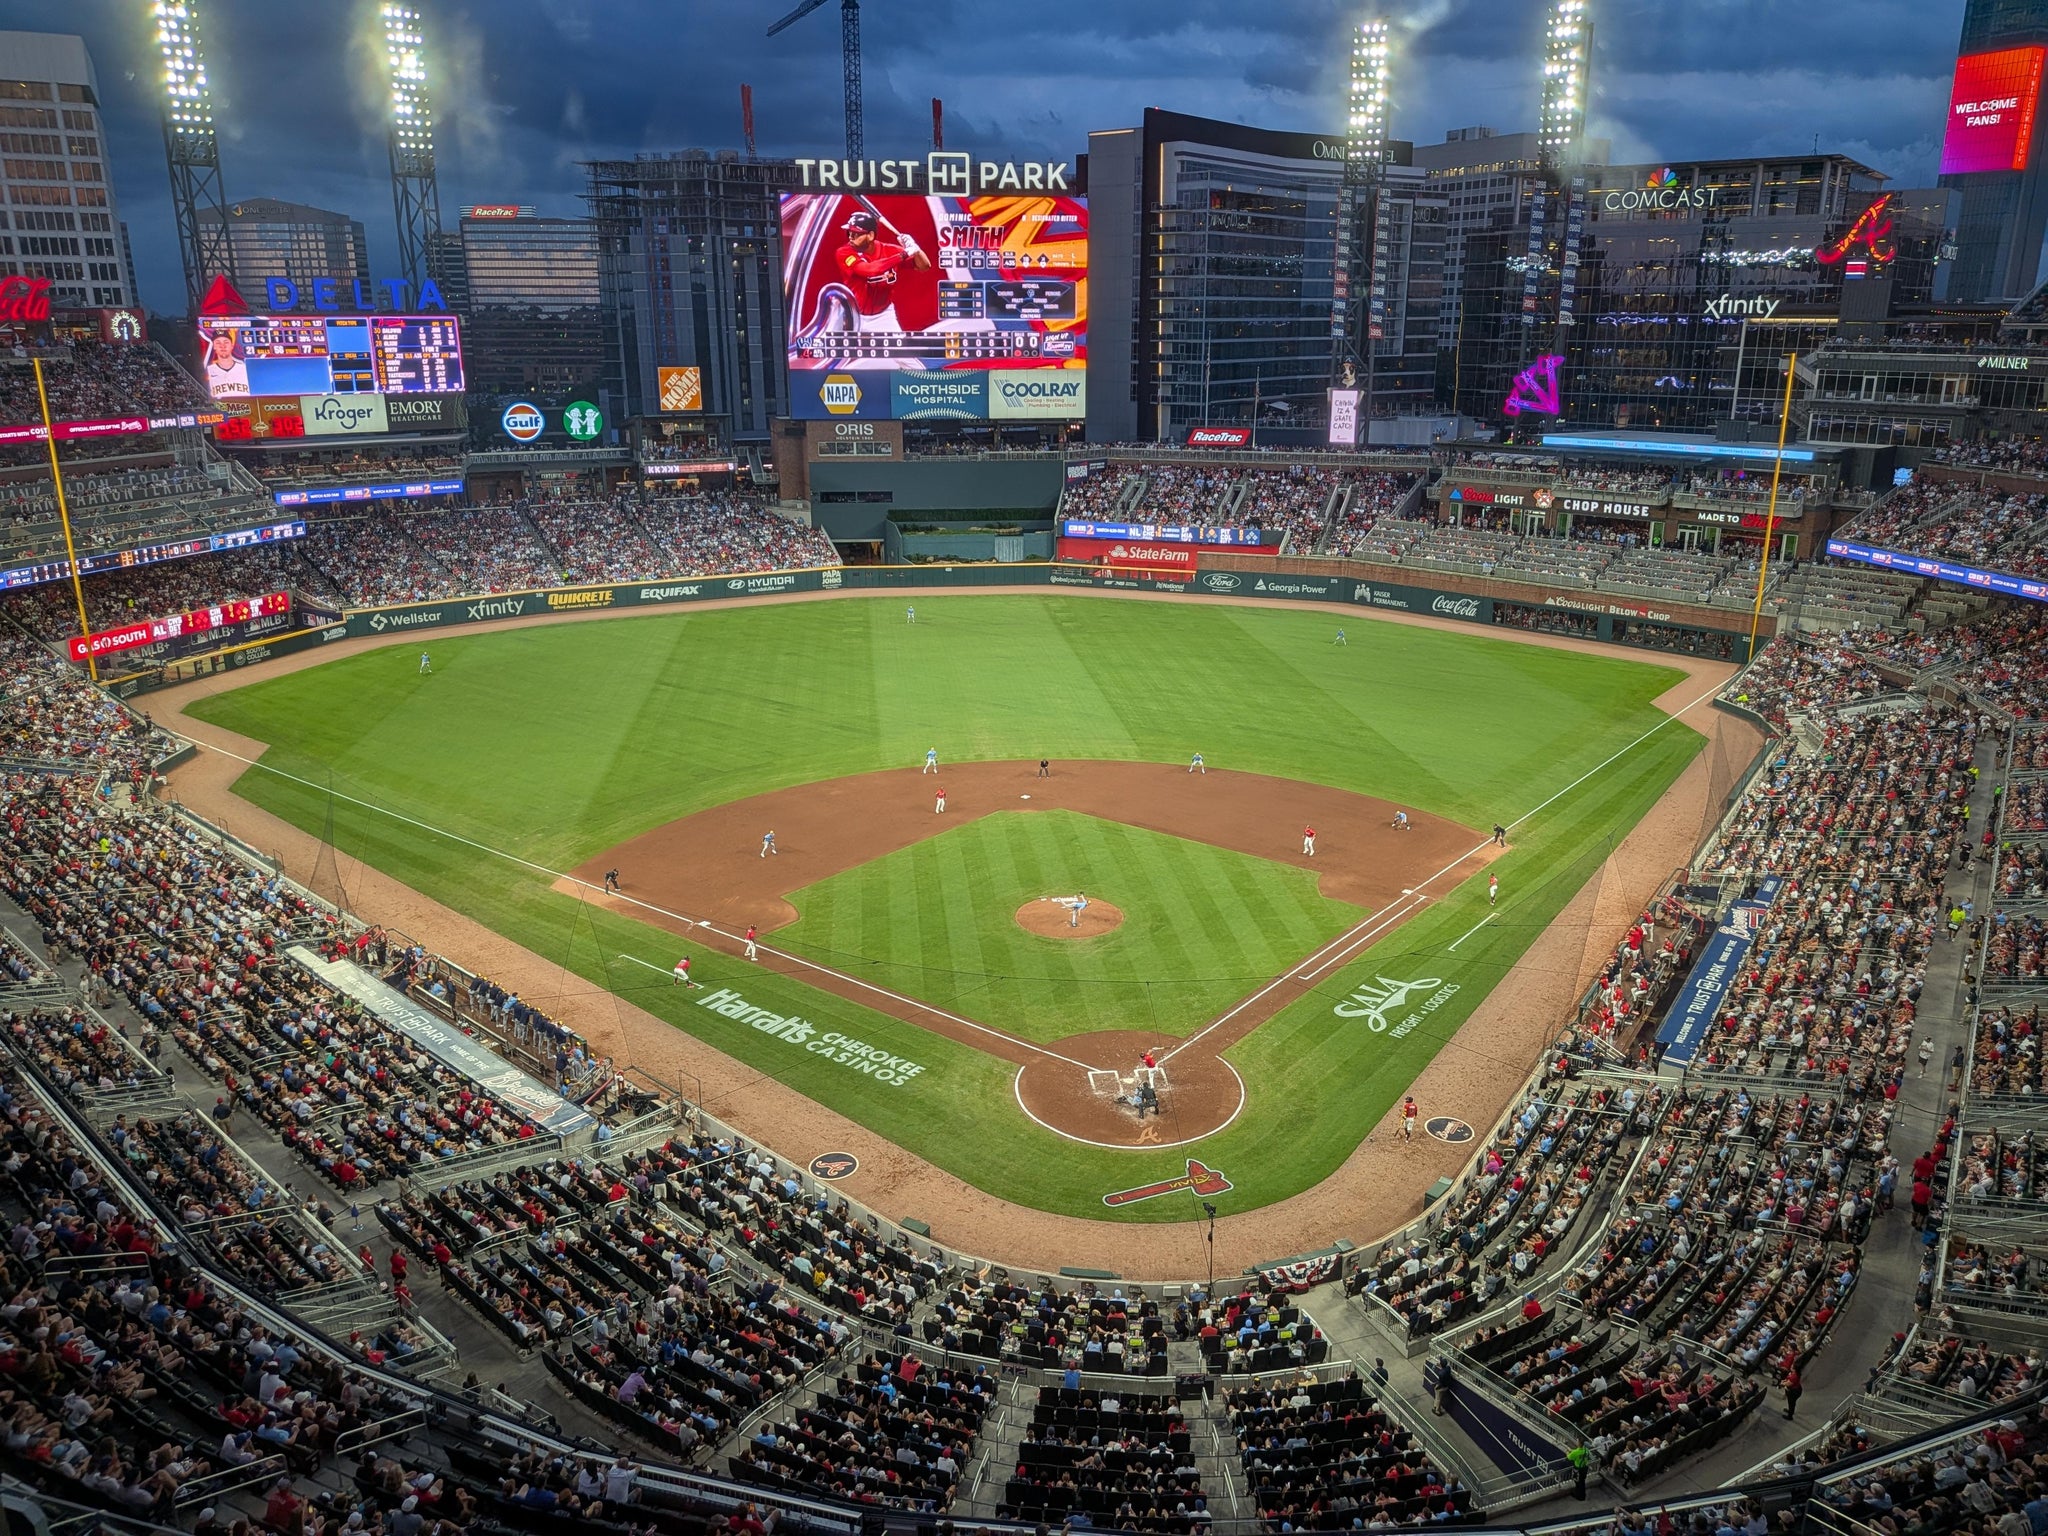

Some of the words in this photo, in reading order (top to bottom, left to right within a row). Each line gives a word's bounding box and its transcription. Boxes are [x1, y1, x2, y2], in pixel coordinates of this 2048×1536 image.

[1955, 97, 2018, 114] WELCOME
[1966, 114, 2001, 127] FANS!
[1313, 141, 1345, 159] OMNI
[795, 159, 919, 188] TRUIST
[980, 161, 1068, 190] PARK
[1605, 188, 1718, 210] COMCAST
[475, 208, 514, 217] RaceTrac
[938, 213, 972, 222] DOMINIC
[938, 226, 1004, 248] SMITH
[266, 276, 448, 311] DELTA
[1703, 293, 1780, 319] xfinity
[302, 345, 311, 354] 77
[1016, 337, 1023, 347] 0
[1029, 337, 1037, 348] 0
[1987, 356, 2029, 370] MILNER
[661, 367, 698, 410] HOME
[664, 372, 680, 389] THE
[677, 384, 700, 409] DEPOT
[826, 386, 856, 403] NAPA
[899, 384, 980, 395] NORTHSIDE
[1002, 382, 1081, 397] COOLRAY
[227, 403, 251, 412] MEGA
[390, 400, 442, 415] EMORY
[914, 396, 966, 404] HOSPITAL
[315, 398, 373, 430] Kroger
[391, 413, 442, 422] HEALTHCARE
[505, 416, 541, 429] Gulf
[835, 424, 874, 435] ORIS
[1193, 431, 1242, 442] RaceTrac
[1462, 487, 1495, 503] Coors
[1494, 494, 1525, 506] LIGHT
[1563, 499, 1600, 512] CHOP
[1603, 502, 1649, 517] HOUSE
[1698, 511, 1725, 522] MADE
[1726, 514, 1739, 523] TO
[1129, 527, 1141, 537] NL
[748, 576, 795, 588] HYUNDAI
[822, 570, 842, 578] PAPA
[1209, 575, 1236, 588] Ford
[640, 585, 700, 600] EQUIFAX
[1268, 582, 1300, 594] Georgia
[1301, 584, 1327, 595] Power
[548, 590, 614, 606] QUIKRETE
[1432, 594, 1480, 617] Coca-Cola
[467, 598, 525, 620] xfinity
[1555, 595, 1581, 611] Coors
[1581, 602, 1606, 613] LIGHT
[1609, 605, 1637, 617] BELOW
[1647, 610, 1670, 621] CHOP
[261, 614, 287, 630] MLB+
[389, 611, 441, 626] Wellstar
[112, 629, 147, 647] SOUTH
[153, 625, 167, 637] AL
[209, 627, 236, 641] MLB+
[140, 641, 171, 657] MLB+
[245, 647, 266, 656] SOUTH
[247, 650, 272, 661] COLLEGE
[1865, 705, 1880, 716] JIM
[1706, 963, 1727, 982] PARK
[1334, 974, 1442, 1033] SAIA
[1687, 989, 1713, 1015] TRUIST
[696, 988, 817, 1044] Harrah's
[1388, 1013, 1425, 1039] FREIGHT
[1425, 983, 1461, 1012] LOGISTICS
[1688, 1016, 1696, 1024] TO
[379, 996, 413, 1023] TRUIST
[421, 1024, 452, 1046] PARK
[448, 1044, 468, 1060] HOME
[474, 1058, 491, 1071] THE
[1674, 1022, 1692, 1044] WELCOME
[822, 1031, 927, 1077] CHEROKEE
[805, 1040, 910, 1087] CASINOS
[479, 1070, 564, 1108] Braves
[1507, 1429, 1537, 1461] TRUIST
